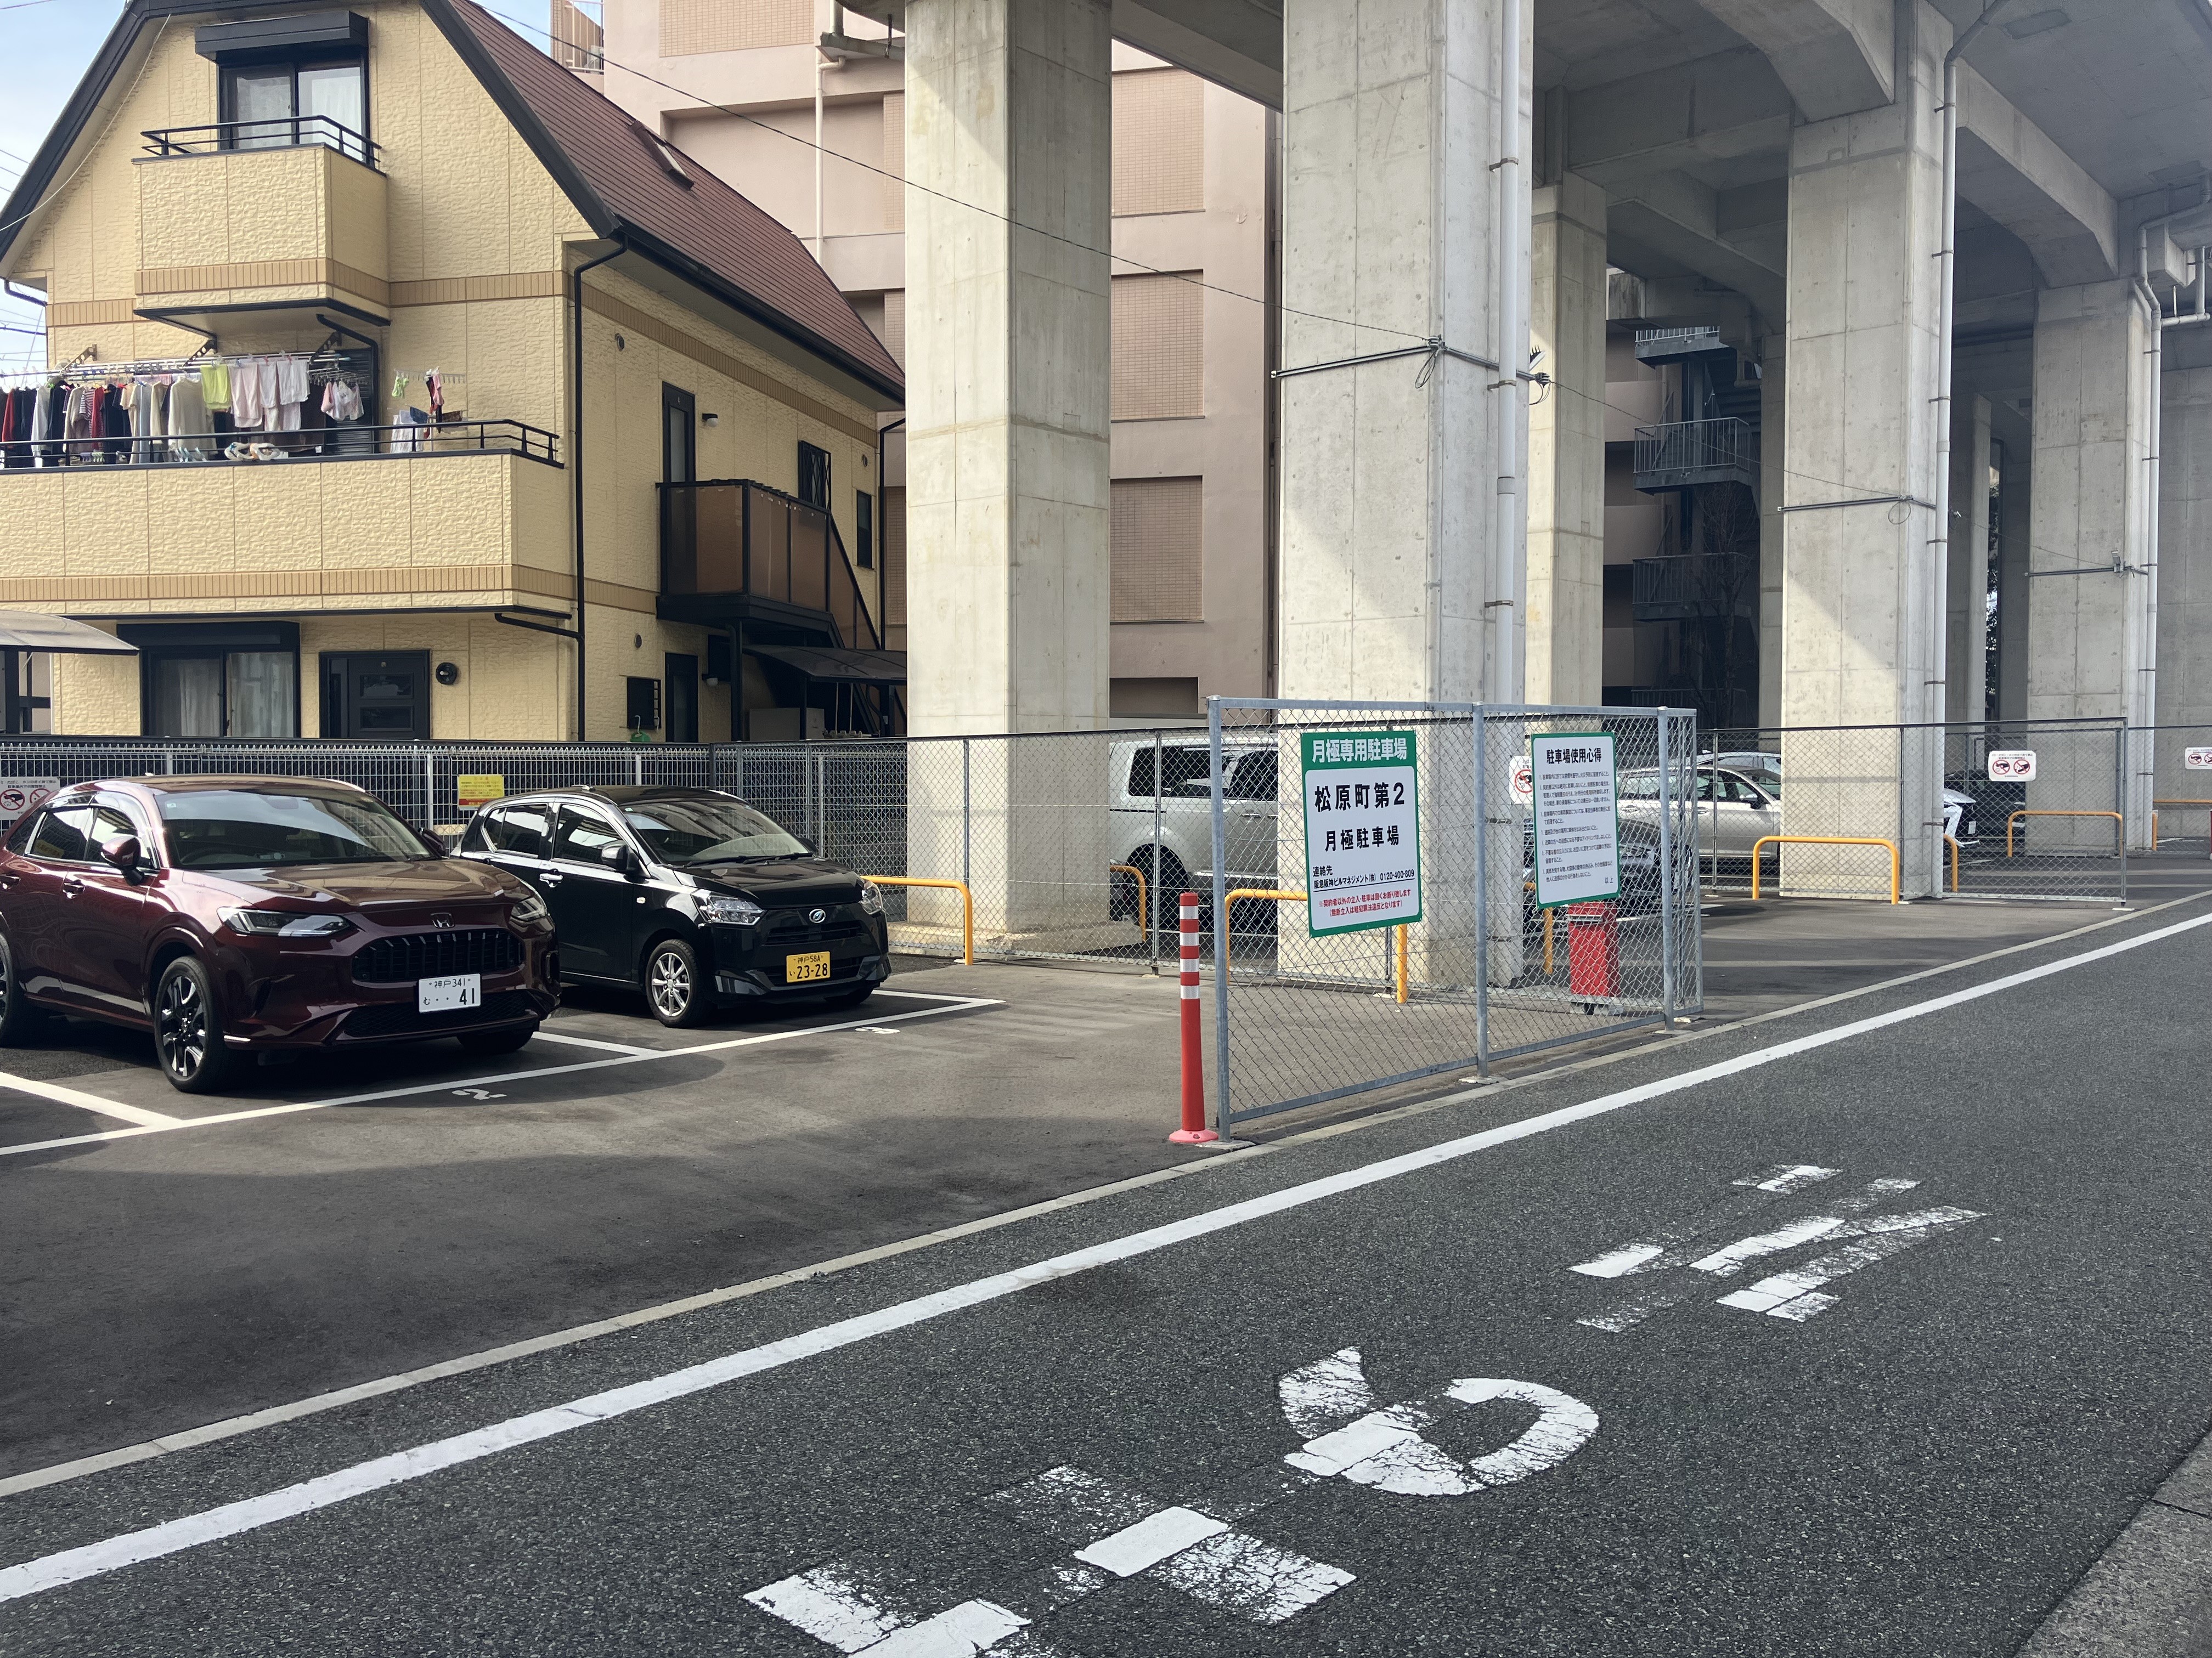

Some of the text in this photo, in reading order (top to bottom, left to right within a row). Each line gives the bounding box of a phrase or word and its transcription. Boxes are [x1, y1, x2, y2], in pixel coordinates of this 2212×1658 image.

[1312, 738, 1407, 763] 月極専用駐車場
[1546, 748, 1602, 765] 駐車場使用心得
[1314, 782, 1404, 812] 松原町第2
[1325, 825, 1399, 852] 月極駐車場
[1313, 864, 1333, 877] 連絡先
[1380, 869, 1414, 881] 0120-400-809
[797, 963, 828, 980] 23-28
